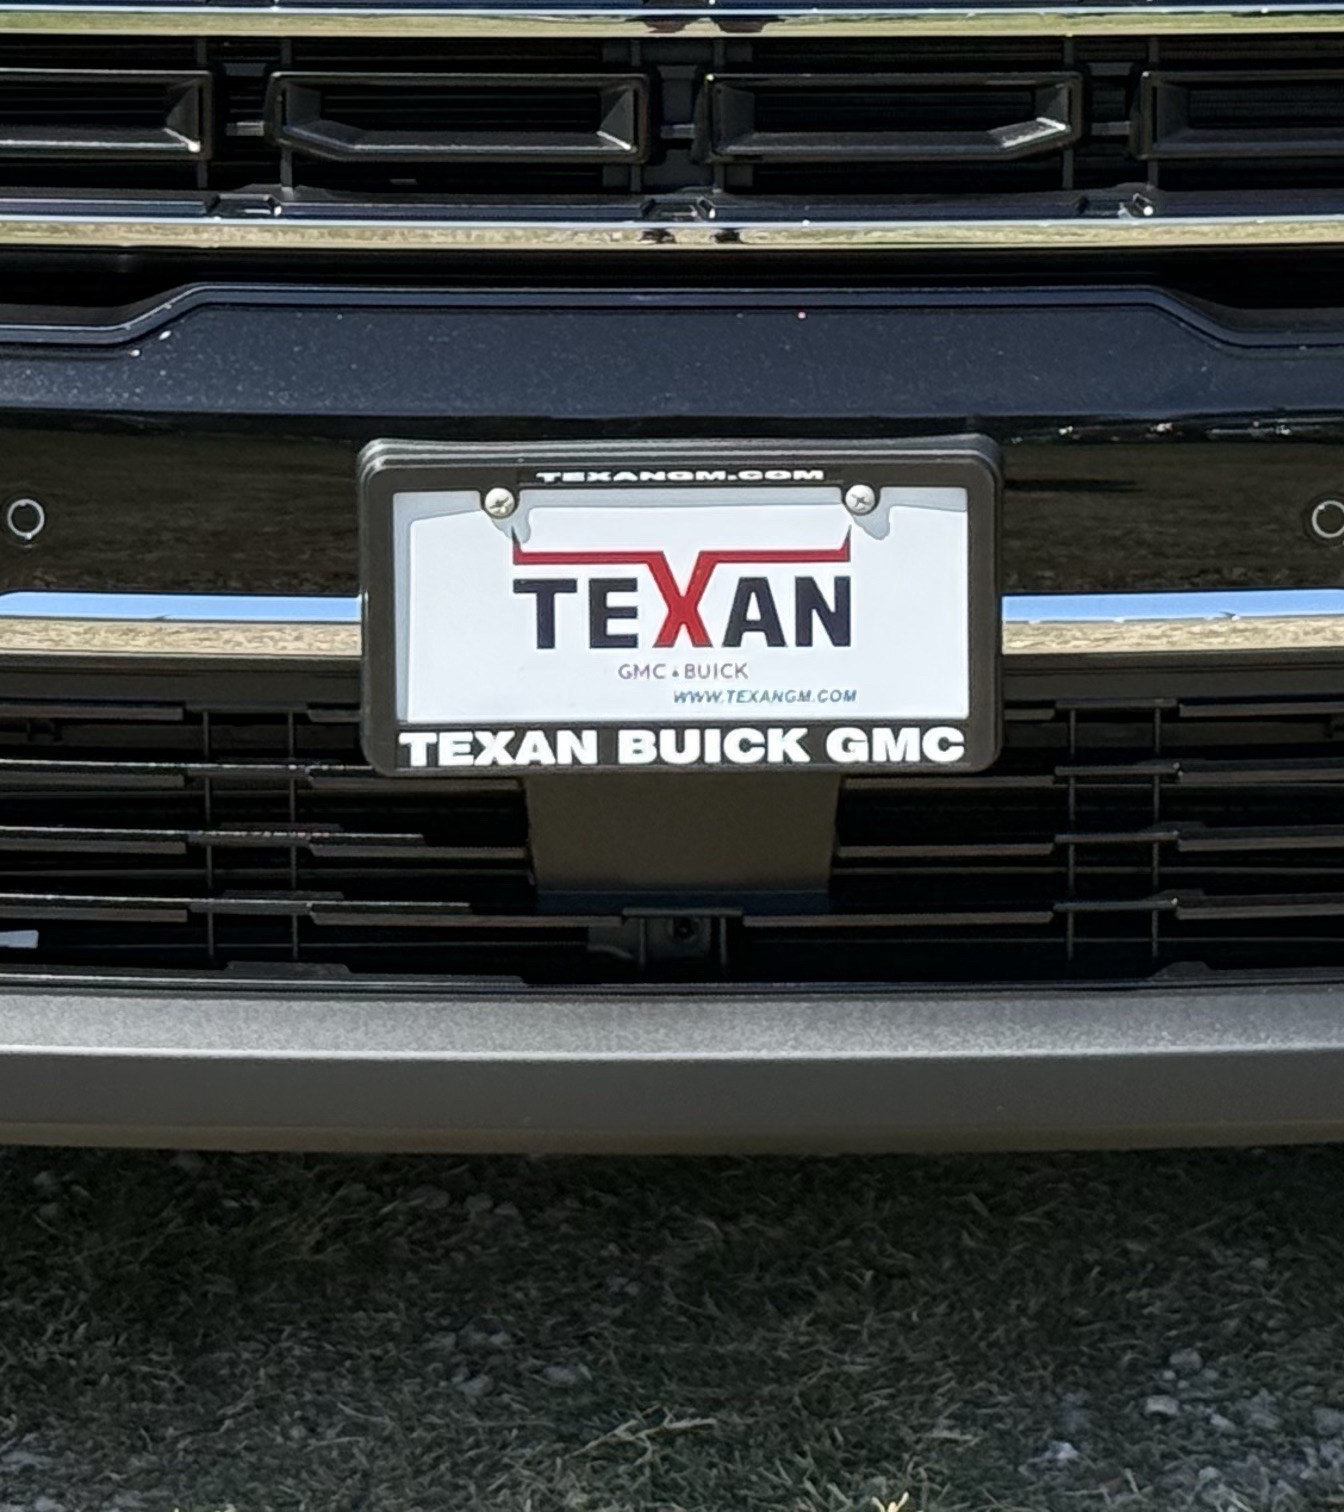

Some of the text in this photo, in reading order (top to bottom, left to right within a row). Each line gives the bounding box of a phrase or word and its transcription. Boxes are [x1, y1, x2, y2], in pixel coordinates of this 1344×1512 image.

[536, 470, 825, 483] TEXANGM.COM
[512, 550, 852, 649] TEXAN
[617, 662, 749, 680] GMC BUICK
[673, 689, 858, 704] WWW.TEXANGM.COM
[398, 725, 966, 768] TEXAN BUICK GMC
